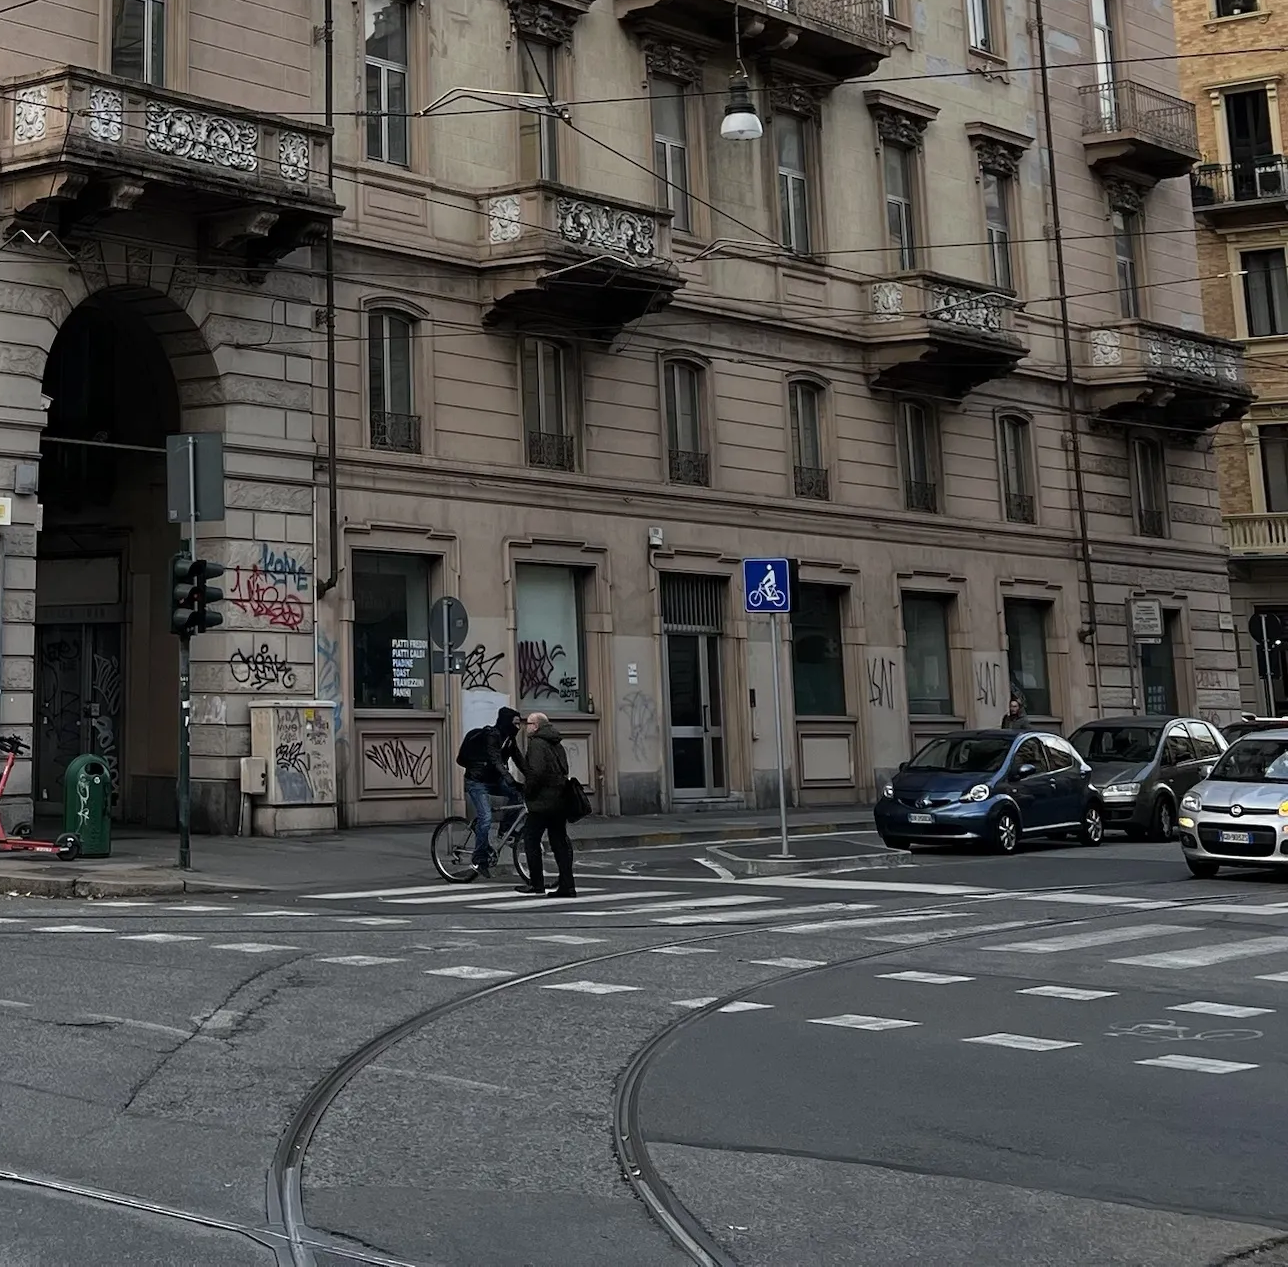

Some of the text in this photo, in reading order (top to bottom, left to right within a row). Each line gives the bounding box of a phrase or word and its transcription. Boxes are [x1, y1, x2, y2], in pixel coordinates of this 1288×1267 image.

[392, 639, 428, 649] PIATTI FREDDI
[392, 649, 425, 659] PIATTI CALDI
[392, 658, 414, 668] PIADINE
[392, 668, 410, 677] TOAST
[393, 678, 424, 687] TRAMEZZINI
[393, 688, 412, 697] PANINI
